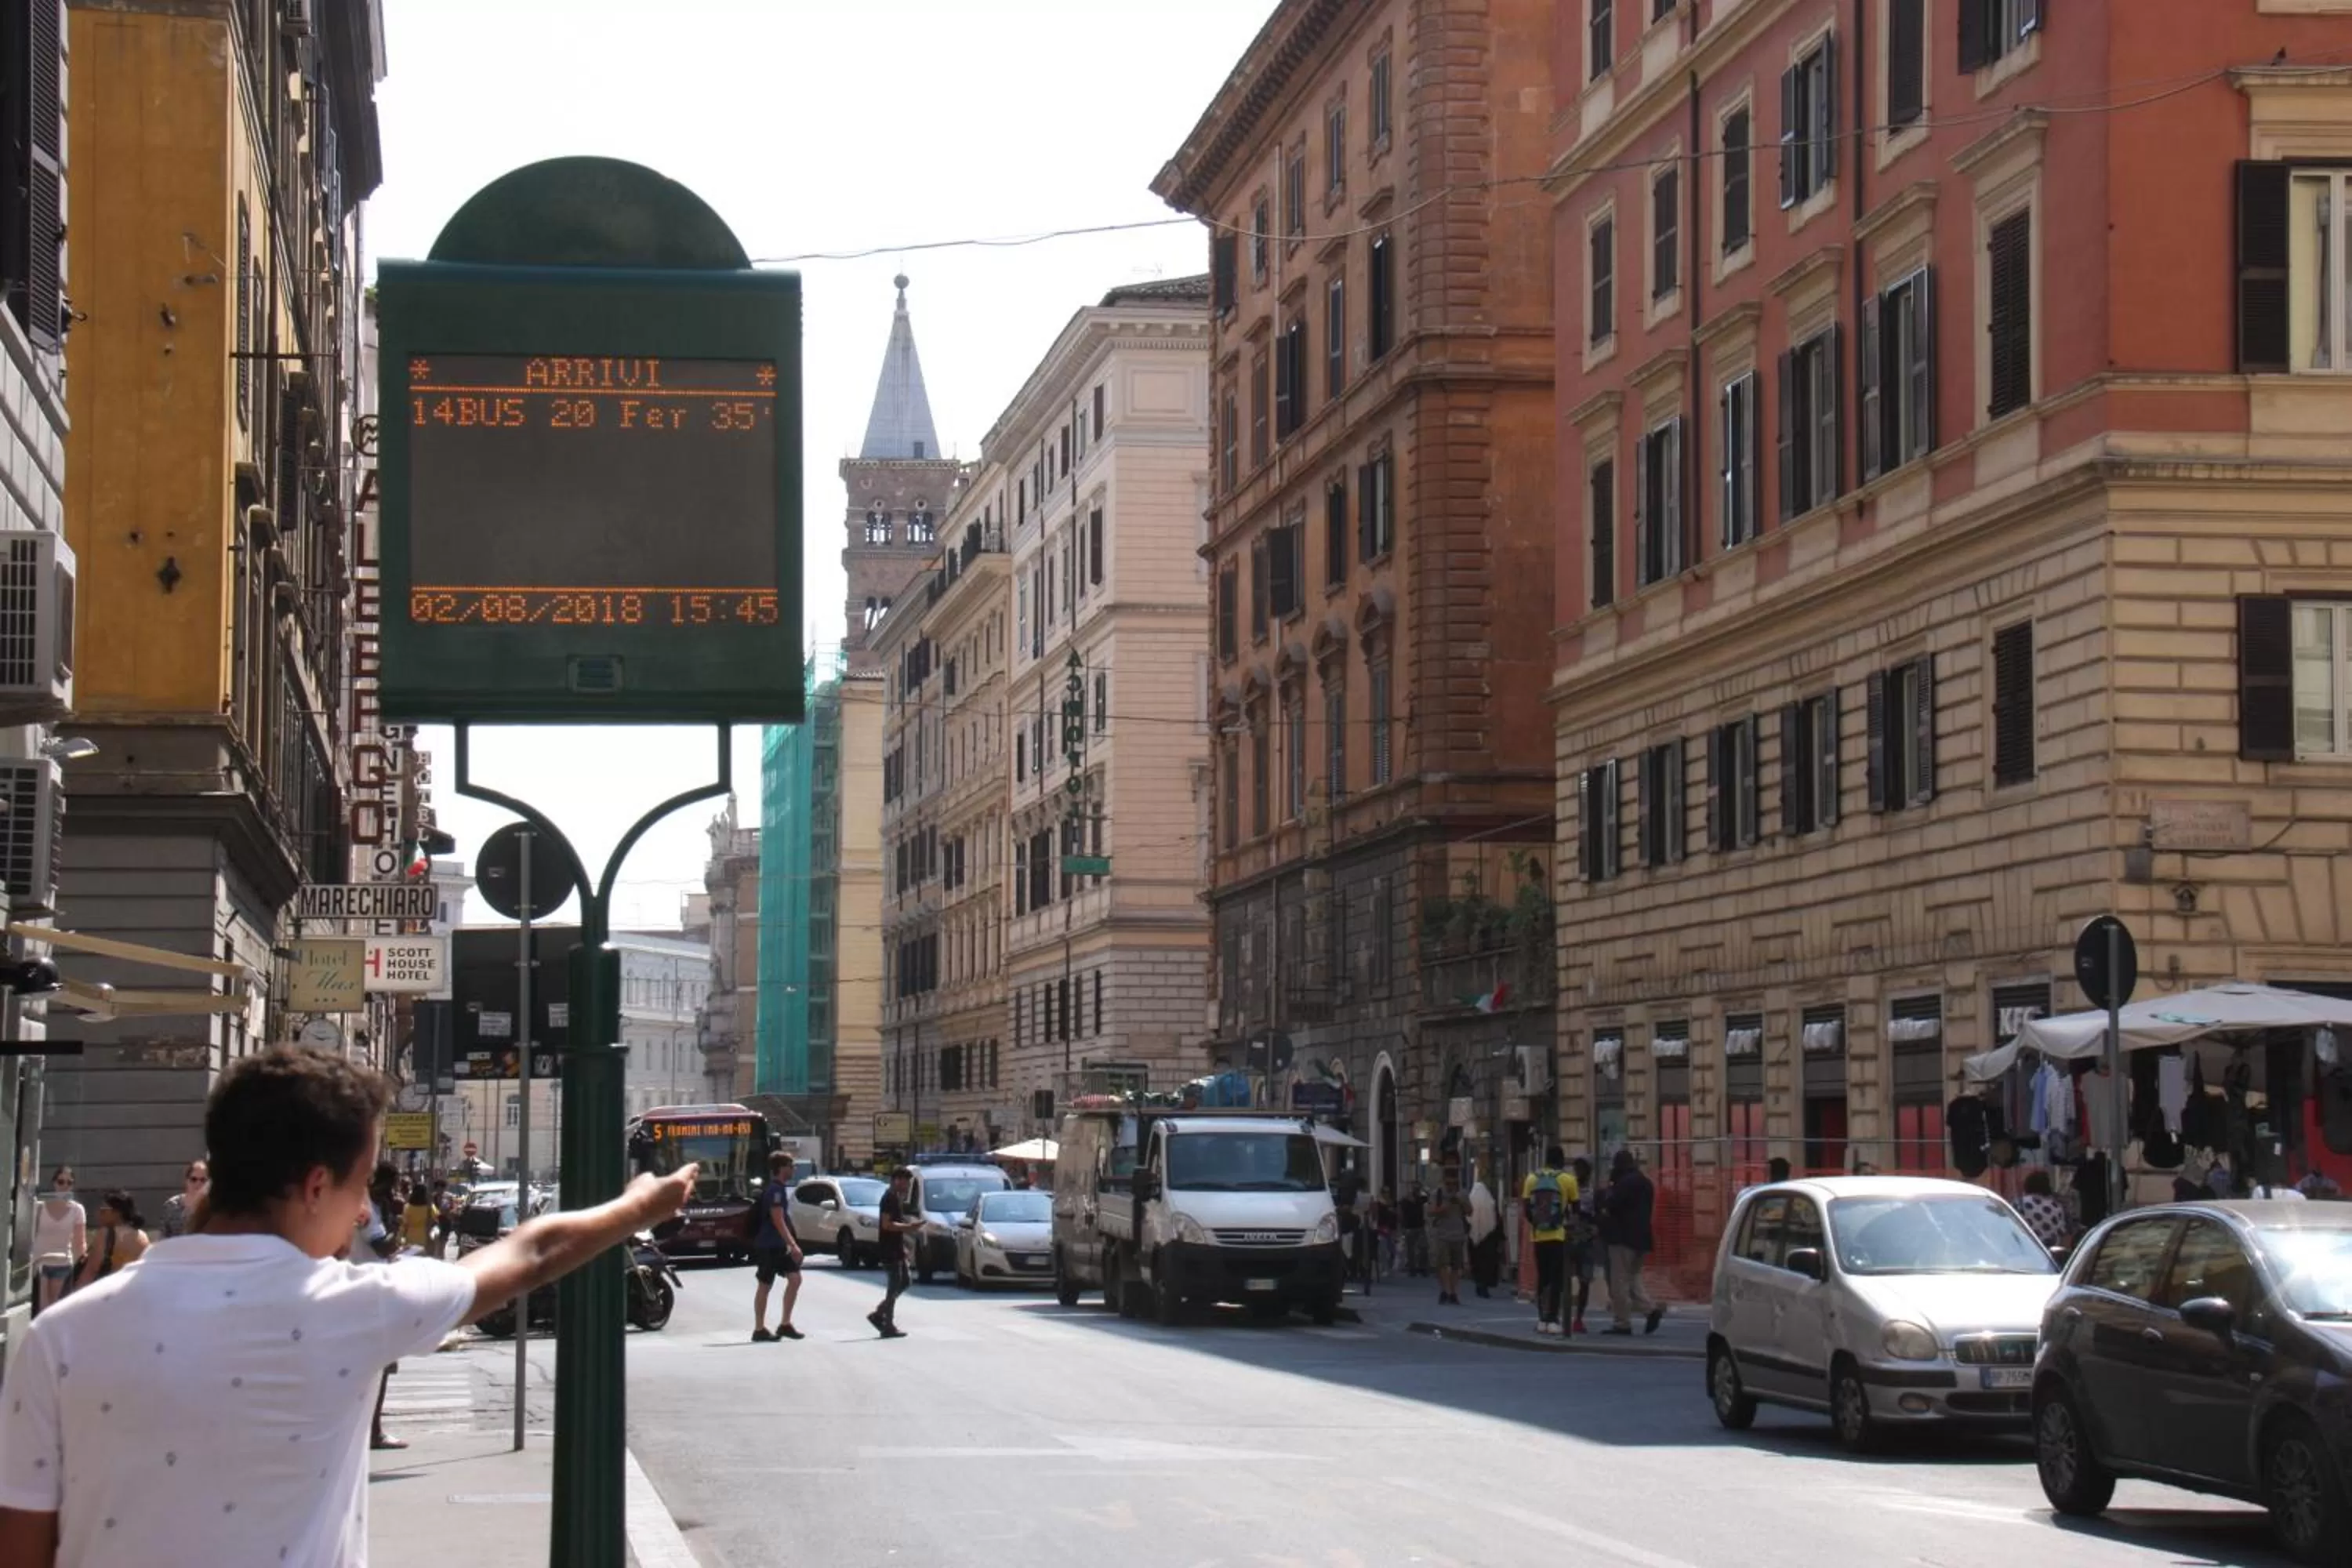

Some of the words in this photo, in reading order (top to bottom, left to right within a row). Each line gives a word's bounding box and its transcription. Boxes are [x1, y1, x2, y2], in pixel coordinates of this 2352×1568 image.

[526, 358, 661, 387] ARRIVI
[413, 397, 526, 427] 14BUS
[550, 400, 596, 428] 20
[620, 400, 687, 429] Fer
[411, 593, 643, 622] 02/08/2018
[671, 596, 778, 624] 15:45
[300, 887, 434, 916] MARECHIARO
[387, 947, 433, 958] SCOTT
[387, 958, 437, 970] HOUSE
[387, 969, 430, 981] HOTEL
